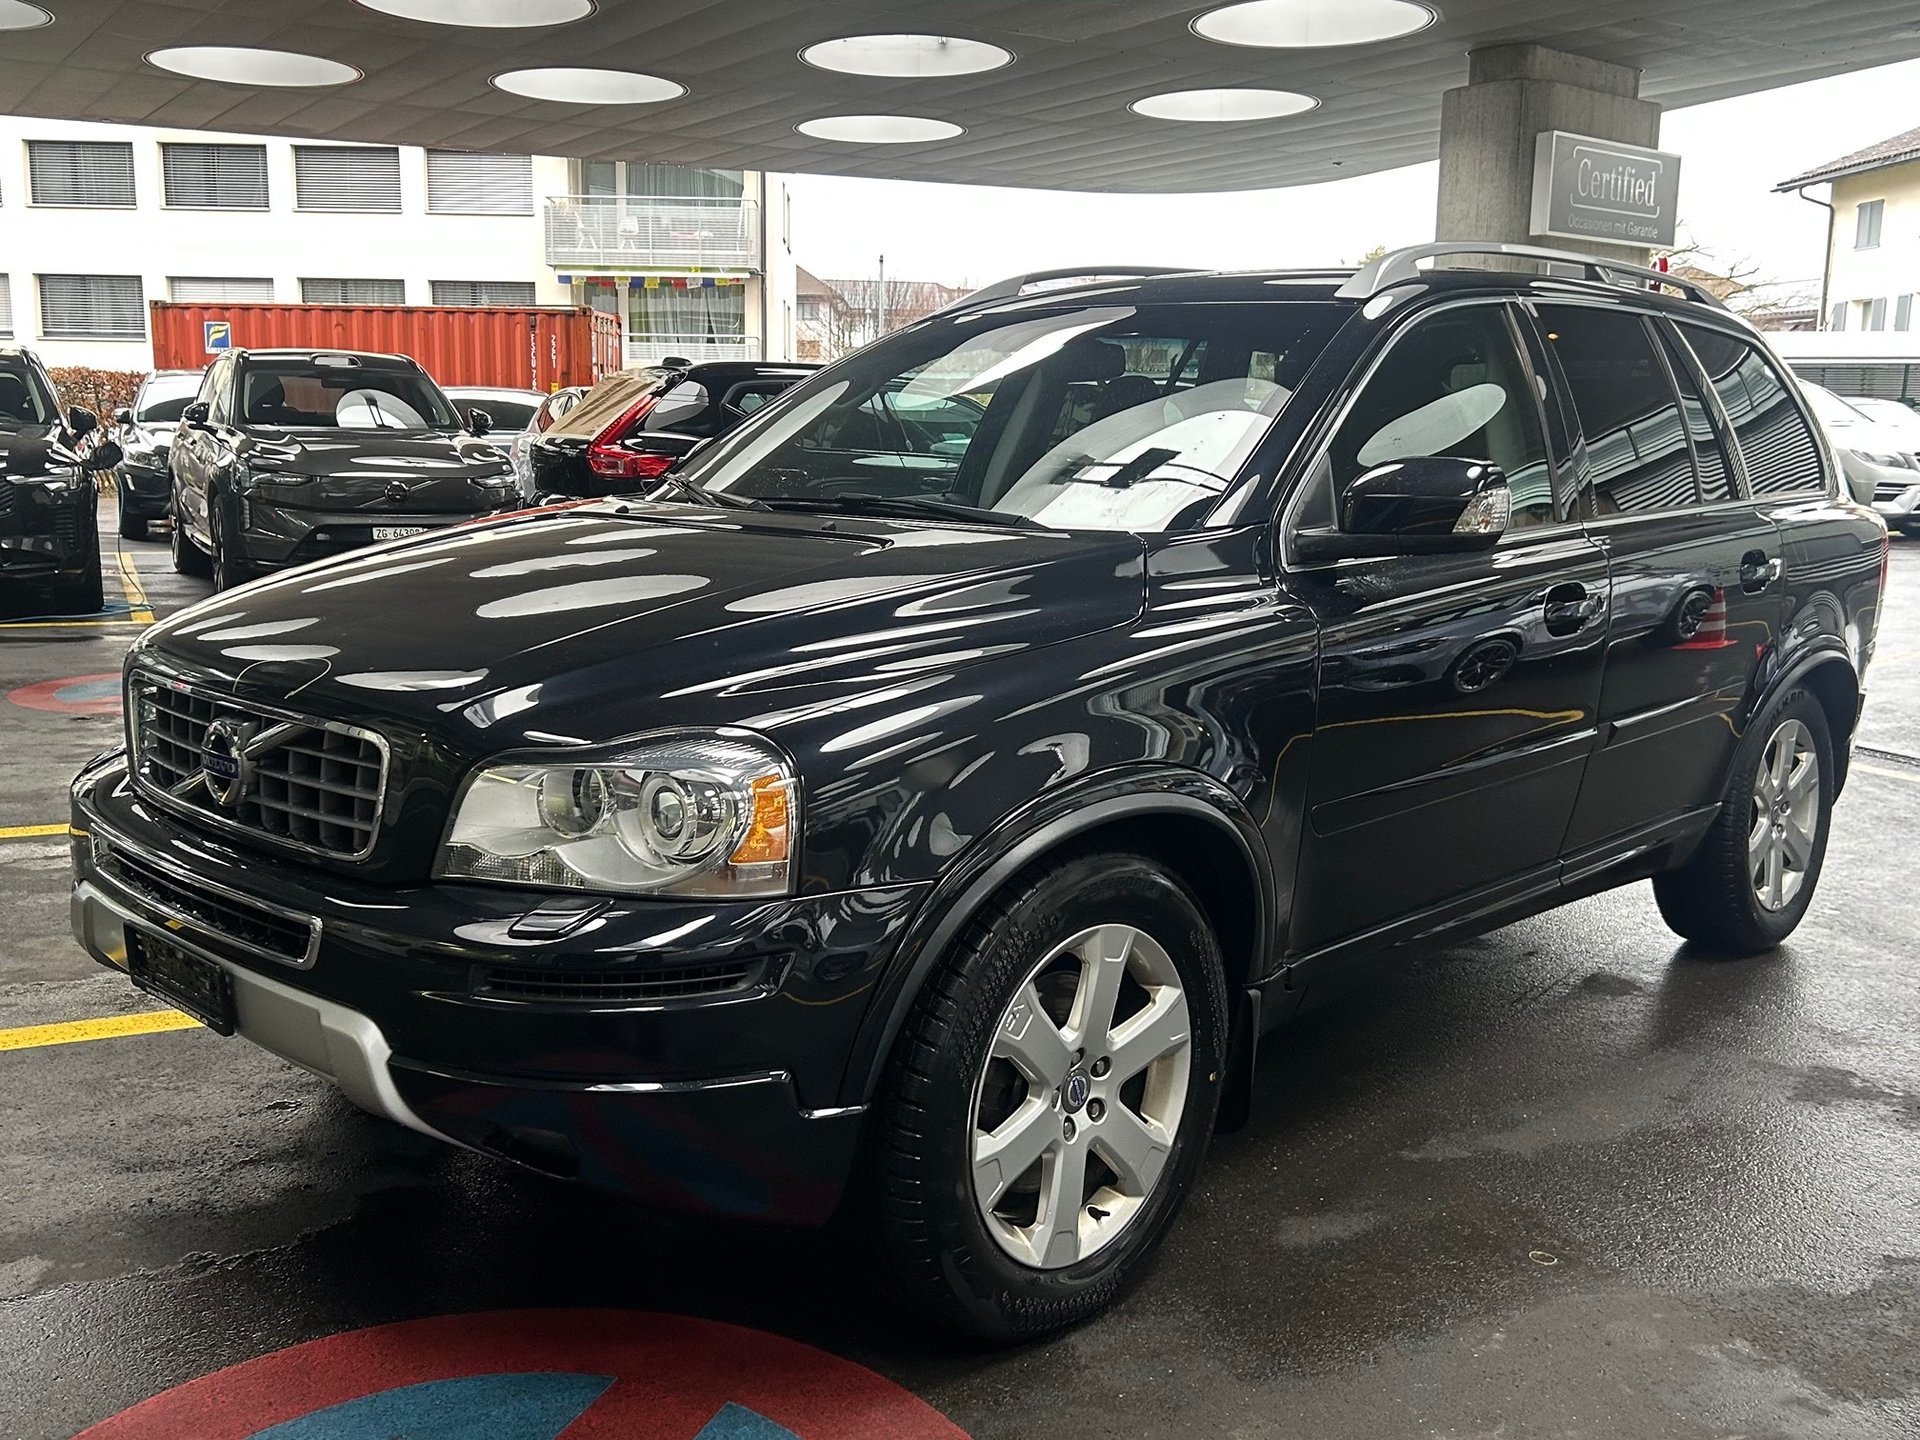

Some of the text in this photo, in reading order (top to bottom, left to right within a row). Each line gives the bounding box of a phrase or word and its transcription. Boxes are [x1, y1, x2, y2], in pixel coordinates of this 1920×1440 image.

[1578, 158, 1656, 207] Certified
[1568, 213, 1658, 239] Occasionen mit Garantie
[202, 752, 236, 774] VOLVO
